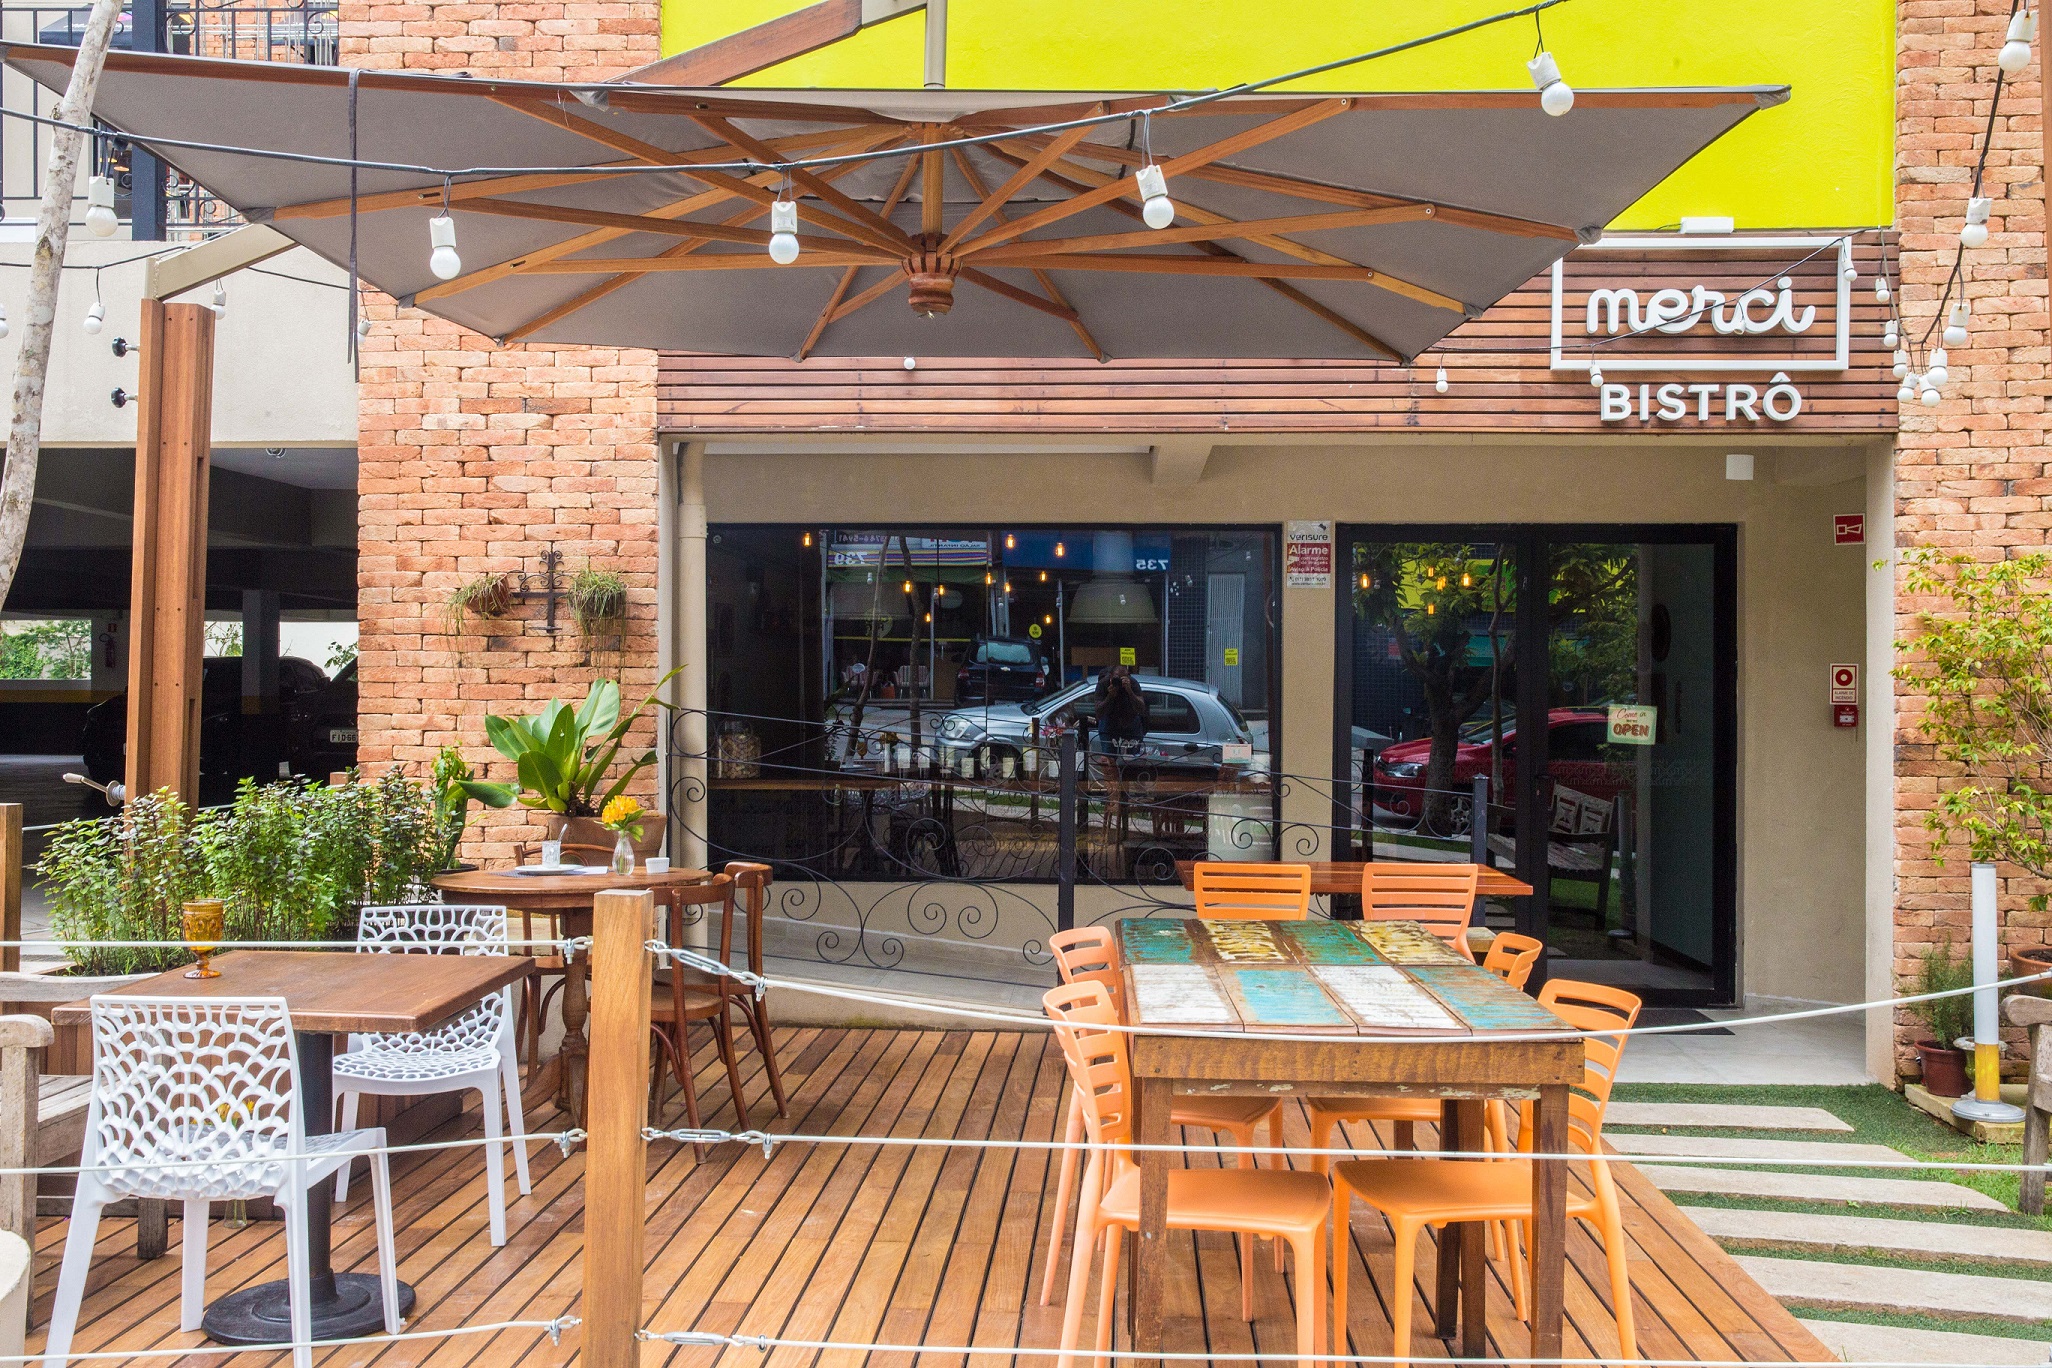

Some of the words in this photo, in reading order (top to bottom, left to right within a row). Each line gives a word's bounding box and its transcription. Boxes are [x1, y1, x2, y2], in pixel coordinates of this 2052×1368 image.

[1586, 276, 1816, 334] merci
[1600, 371, 1802, 422] BISTRÔ
[1288, 544, 1328, 554] Alarme
[1613, 723, 1649, 737] OPEN
